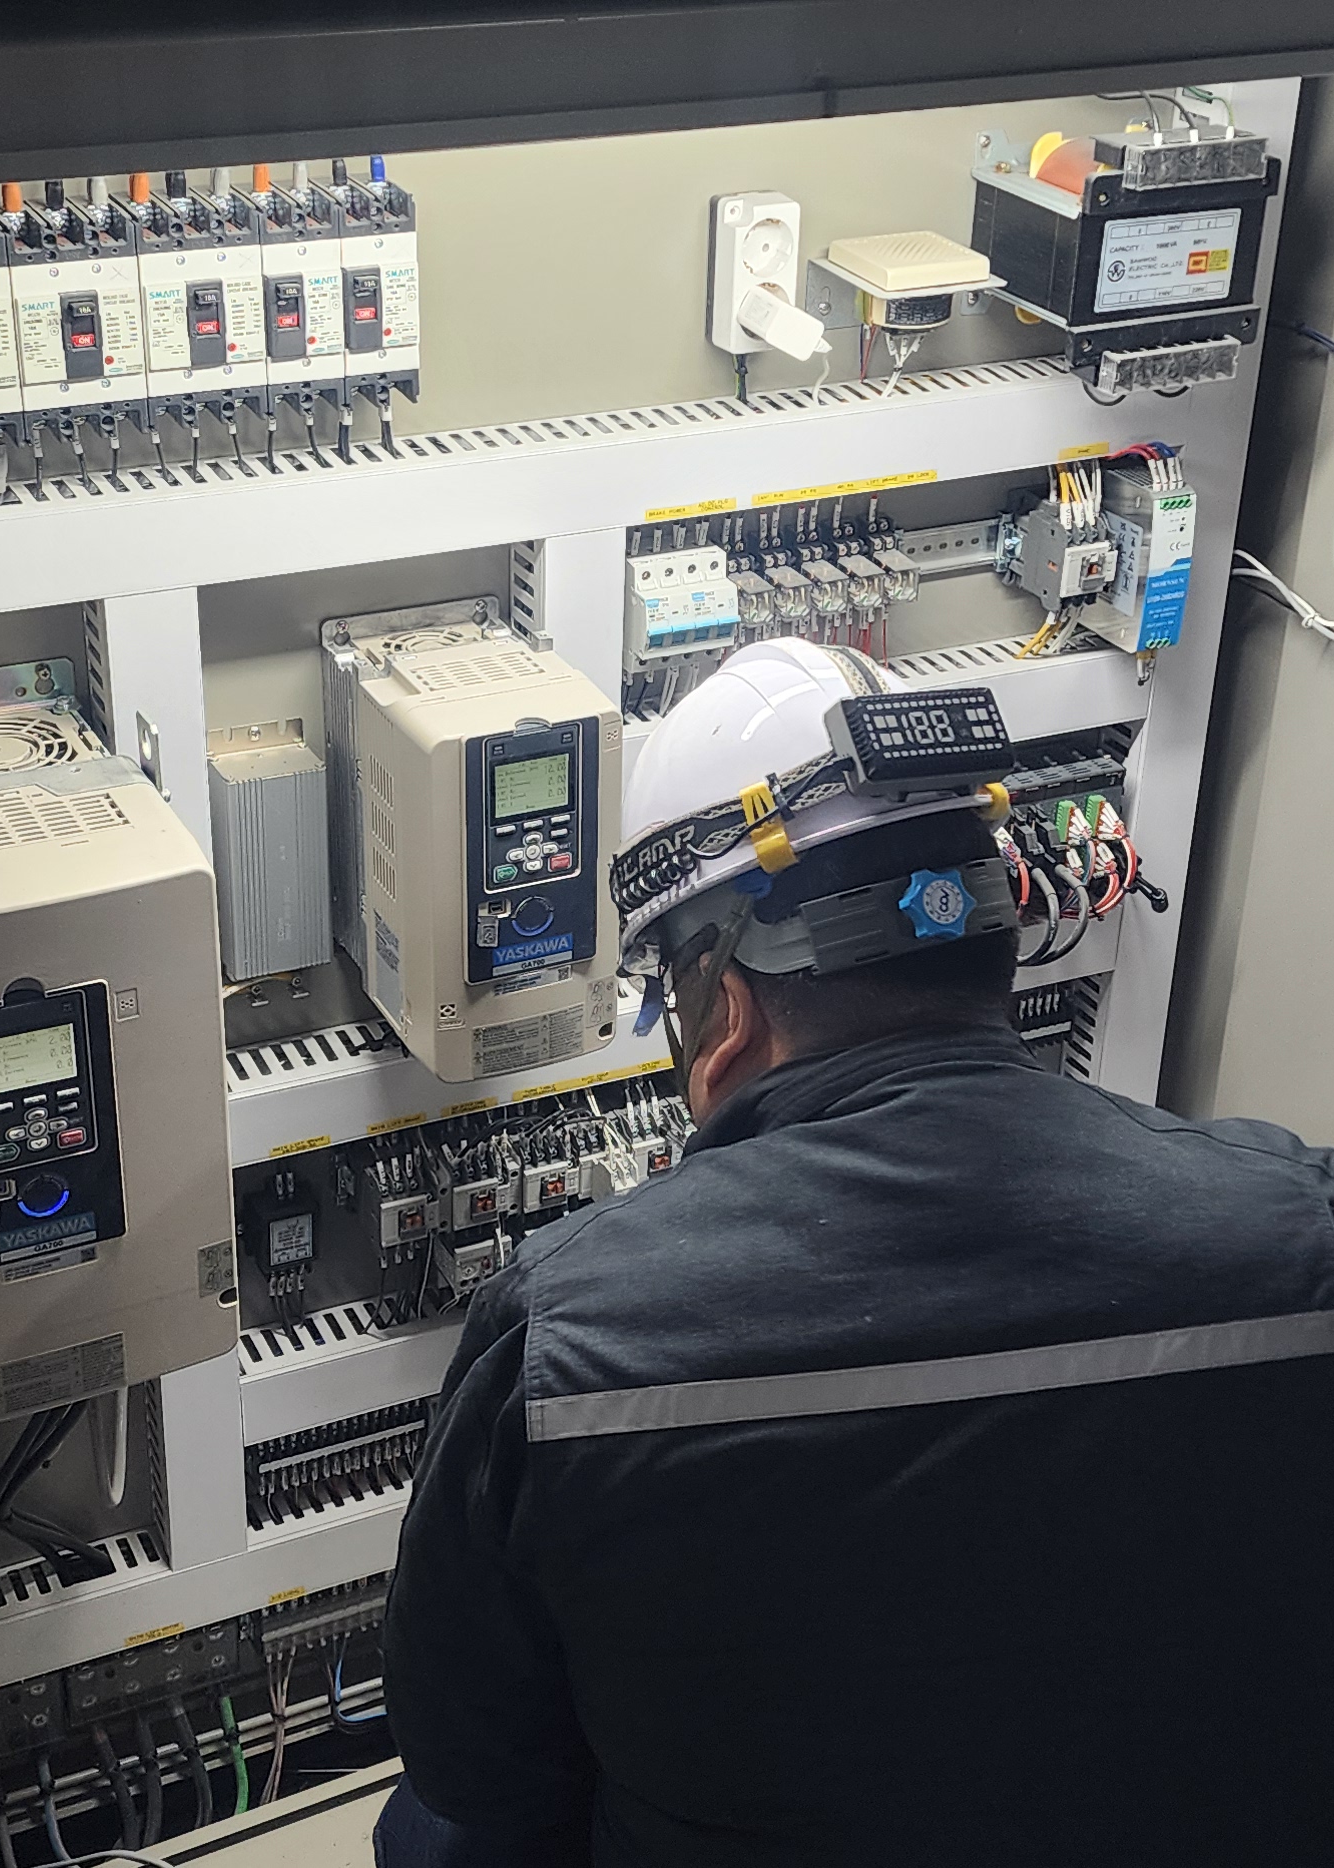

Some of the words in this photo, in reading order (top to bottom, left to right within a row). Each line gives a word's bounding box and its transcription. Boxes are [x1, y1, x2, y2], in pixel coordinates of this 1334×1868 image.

[385, 268, 414, 278] SMART
[308, 276, 338, 286] SMART
[149, 289, 181, 299] SMART
[21, 302, 55, 312] SMART
[359, 310, 371, 318] ON
[282, 317, 293, 325] ON
[202, 324, 215, 332] ON
[78, 336, 91, 344] ON
[901, 709, 956, 745] 188
[496, 937, 569, 962] YASKAWA
[521, 958, 546, 969] GA700
[3, 1216, 91, 1248] YASKAWA
